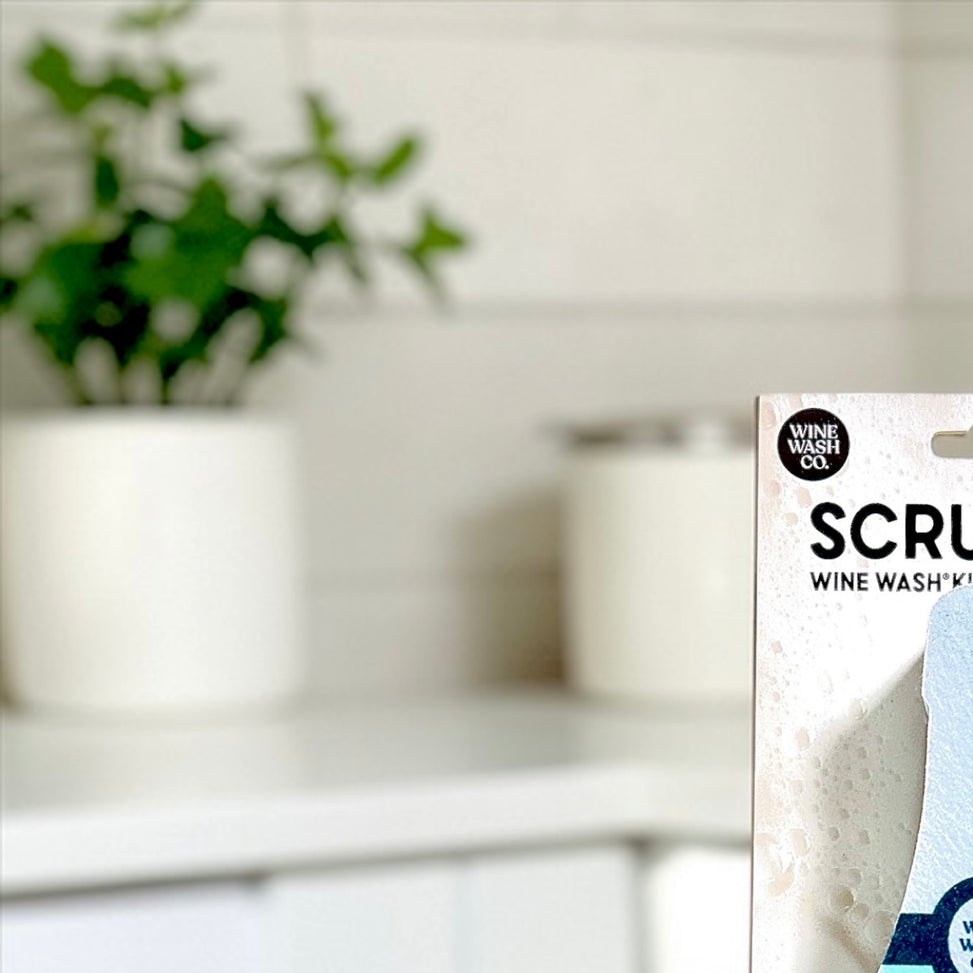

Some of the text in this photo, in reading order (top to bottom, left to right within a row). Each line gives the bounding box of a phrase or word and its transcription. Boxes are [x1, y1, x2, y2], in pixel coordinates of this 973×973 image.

[789, 422, 839, 439] WINE
[787, 438, 841, 455] WASH
[800, 454, 830, 470] CO.
[810, 572, 869, 591] WINE
